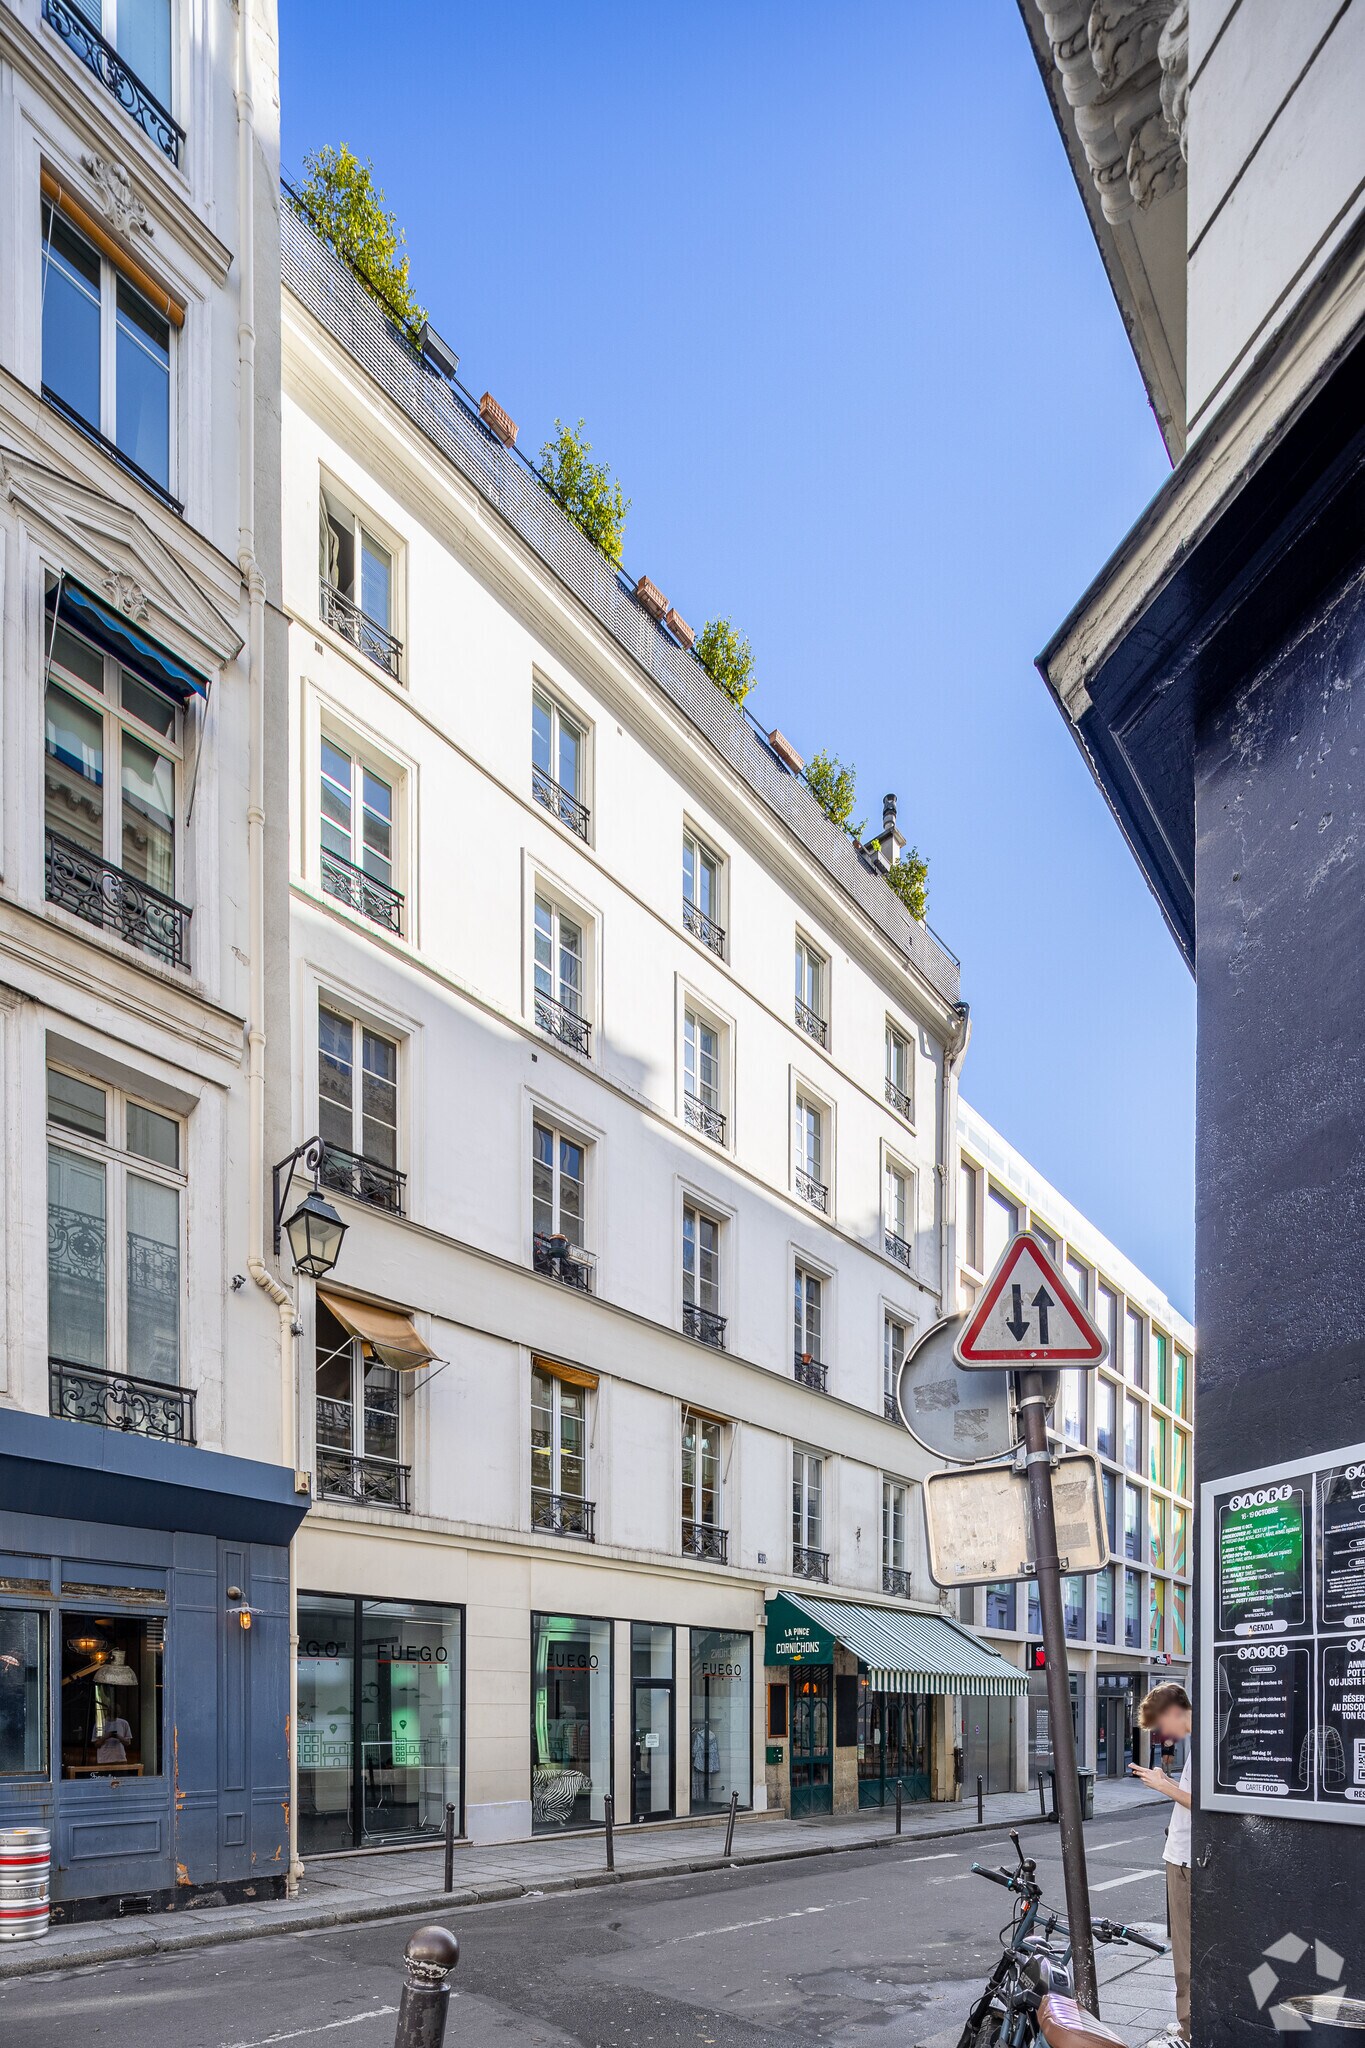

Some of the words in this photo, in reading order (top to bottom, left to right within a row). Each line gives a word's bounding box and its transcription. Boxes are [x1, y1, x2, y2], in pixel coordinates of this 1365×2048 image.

[1231, 1485, 1290, 1510] SACRÉ
[1255, 1506, 1279, 1517] OCTOBRE
[784, 1628, 792, 1637] LA
[793, 1627, 810, 1636] PINCE
[1249, 1623, 1274, 1633] AGENDA
[776, 1641, 820, 1654] CORNICHONS
[1240, 1645, 1285, 1659] SACRÉ
[377, 1645, 448, 1663] FUEGO
[547, 1653, 599, 1668] FUEGO
[702, 1663, 742, 1676] FUEGO
[1347, 1669, 1361, 1677] POT
[1340, 1677, 1361, 1686] JUSTE
[1331, 1703, 1342, 1711] AU
[1341, 1711, 1356, 1719] TON
[1246, 1783, 1262, 1791] CARTE
[1262, 1785, 1279, 1793] FOOD
